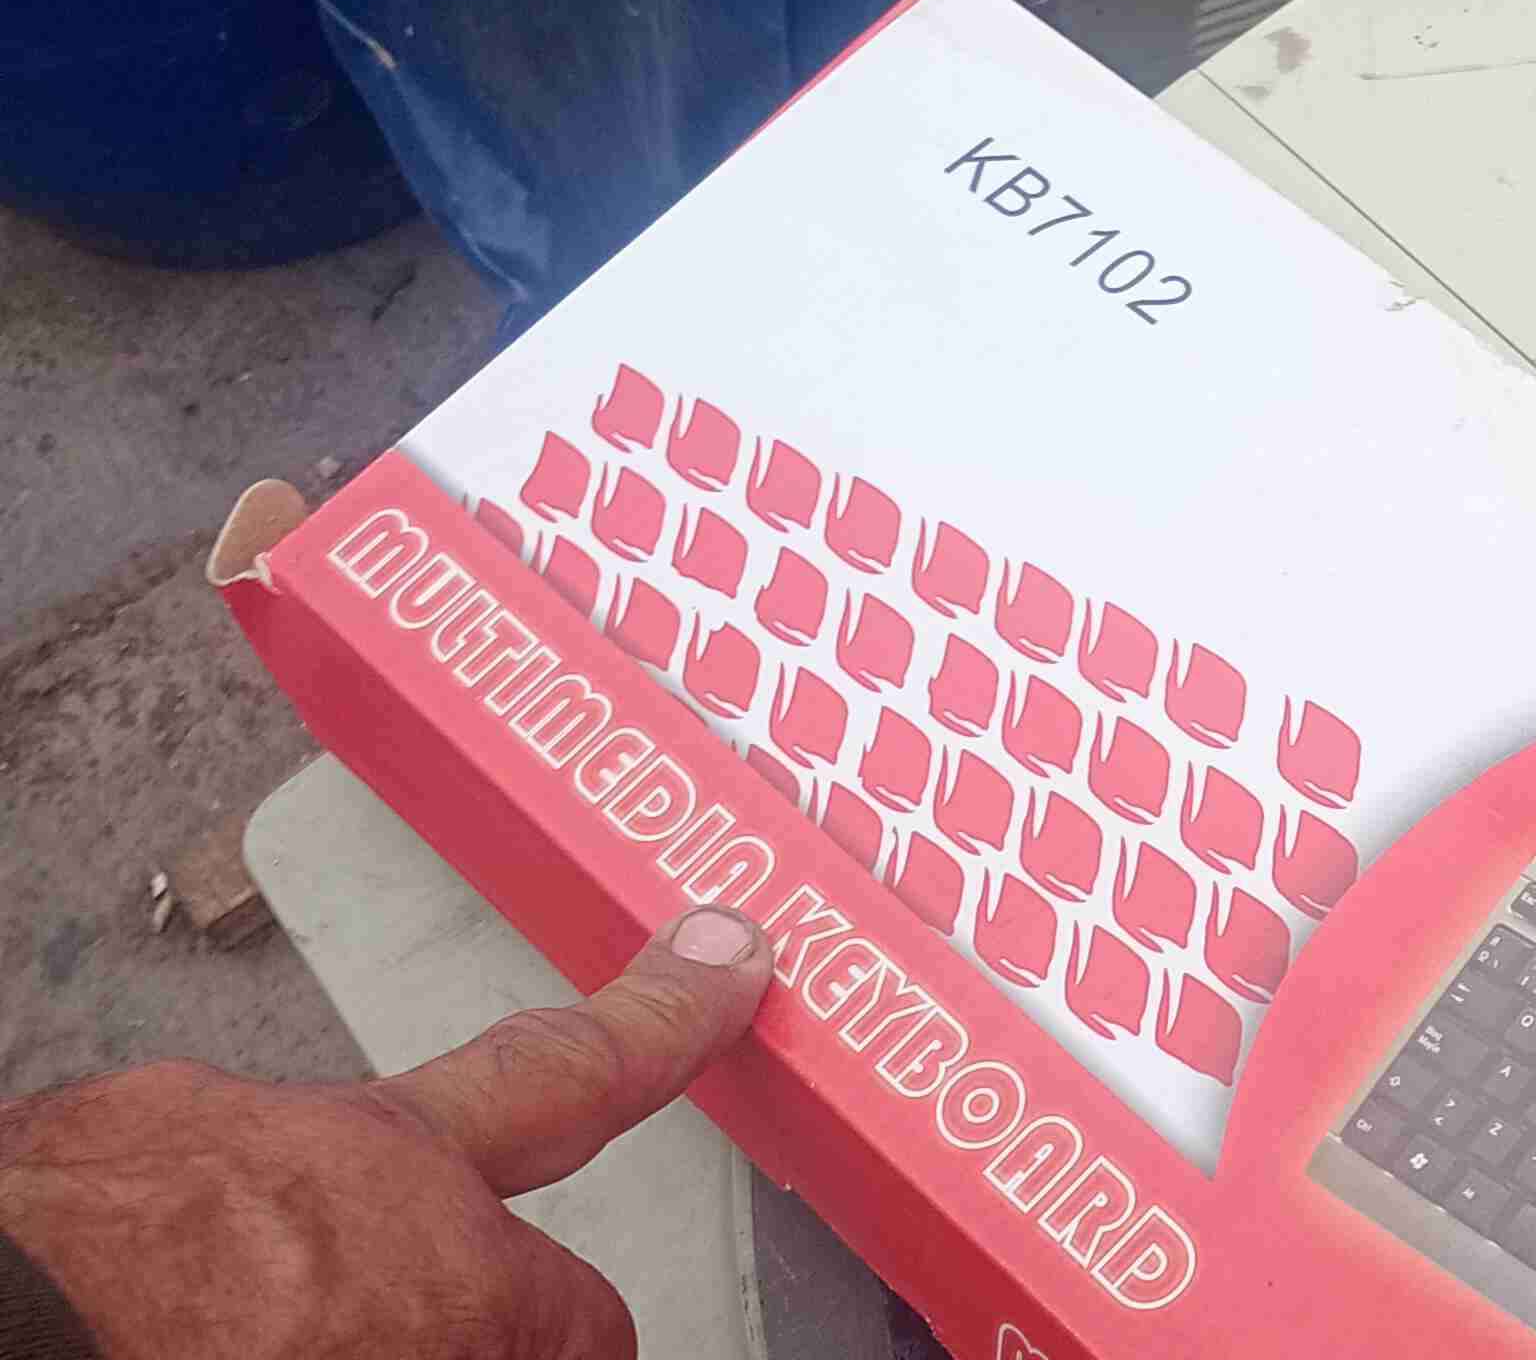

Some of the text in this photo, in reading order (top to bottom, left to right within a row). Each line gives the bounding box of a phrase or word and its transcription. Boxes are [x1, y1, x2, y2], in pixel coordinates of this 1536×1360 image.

[943, 136, 1193, 325] KB7102
[327, 506, 1198, 1312] MULTIMEDIA KEYBOARD
[1500, 1065, 1511, 1078] A
[1489, 1122, 1503, 1136] Z
